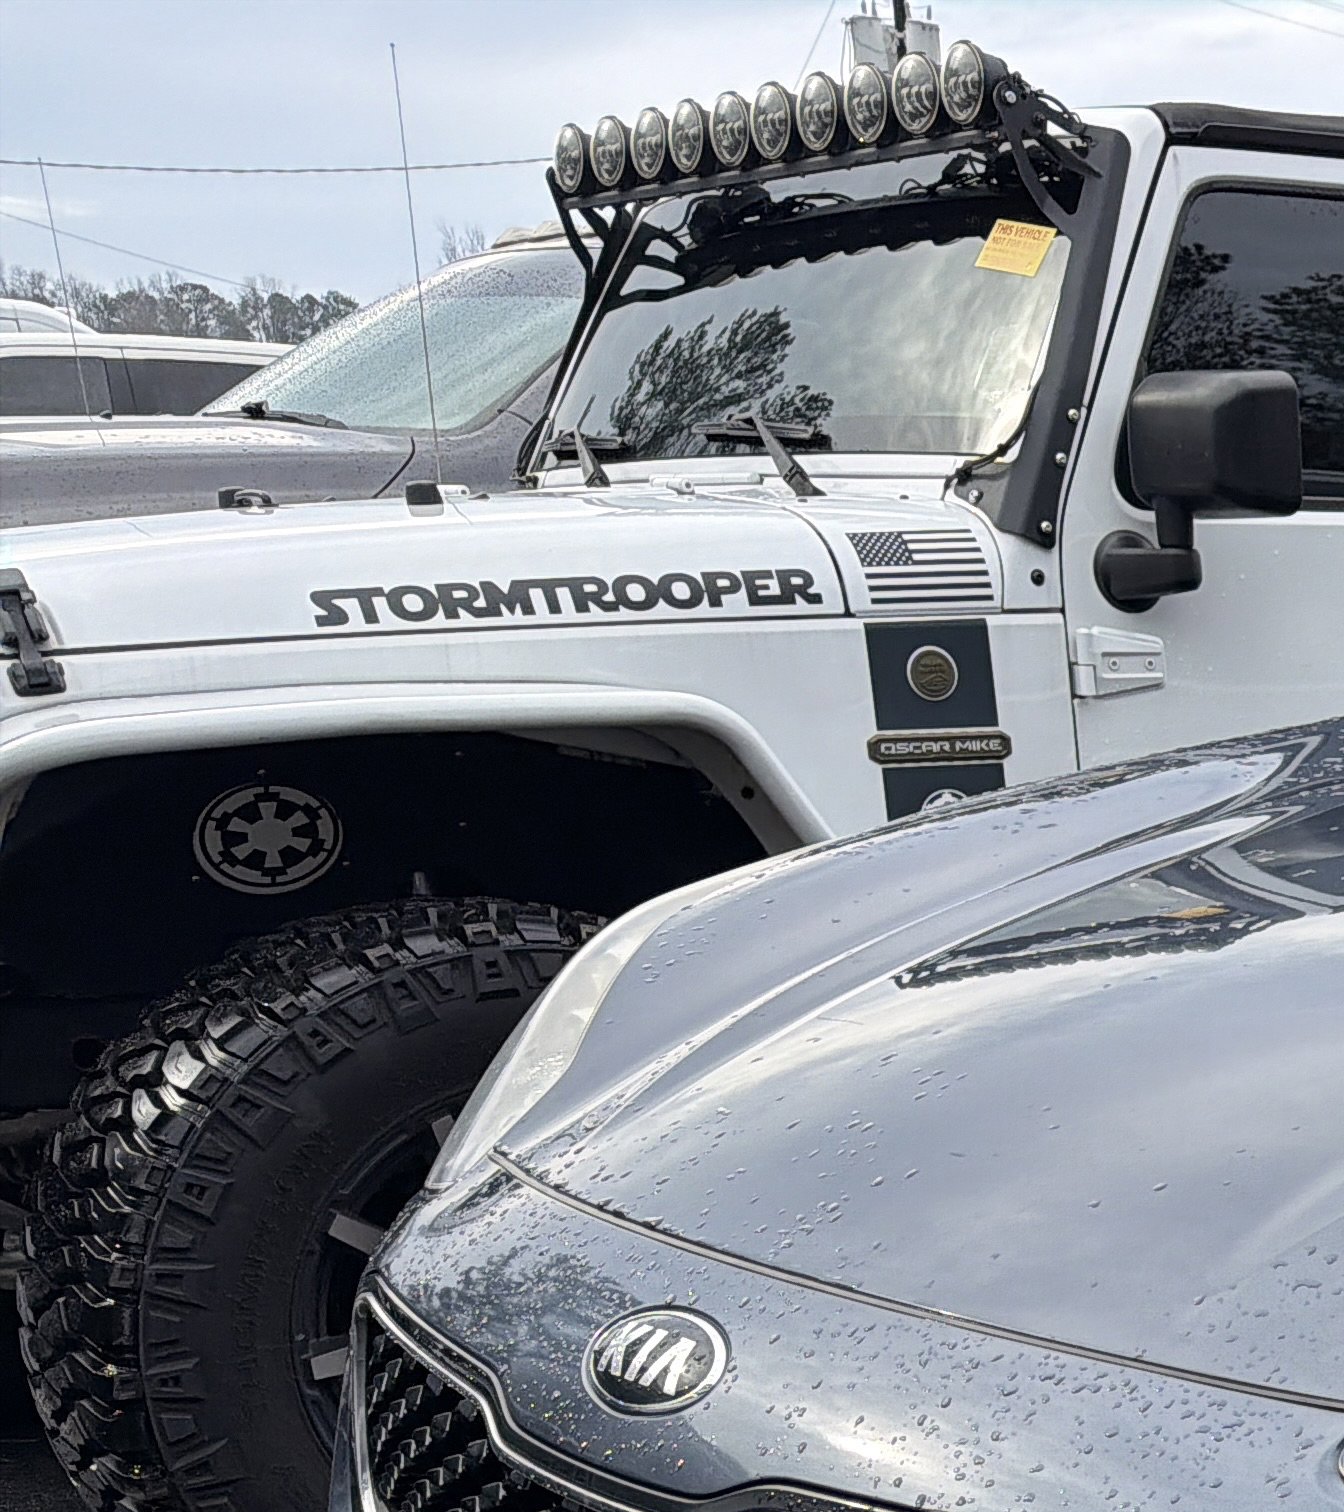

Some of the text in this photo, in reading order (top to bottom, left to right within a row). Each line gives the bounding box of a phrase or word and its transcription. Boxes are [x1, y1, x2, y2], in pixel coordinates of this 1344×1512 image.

[995, 223, 1051, 242] THIS VEHICLE
[309, 569, 824, 628] STORMTROOPER
[880, 738, 1003, 755] OSCAR MIKE
[597, 1320, 697, 1397] KIA
